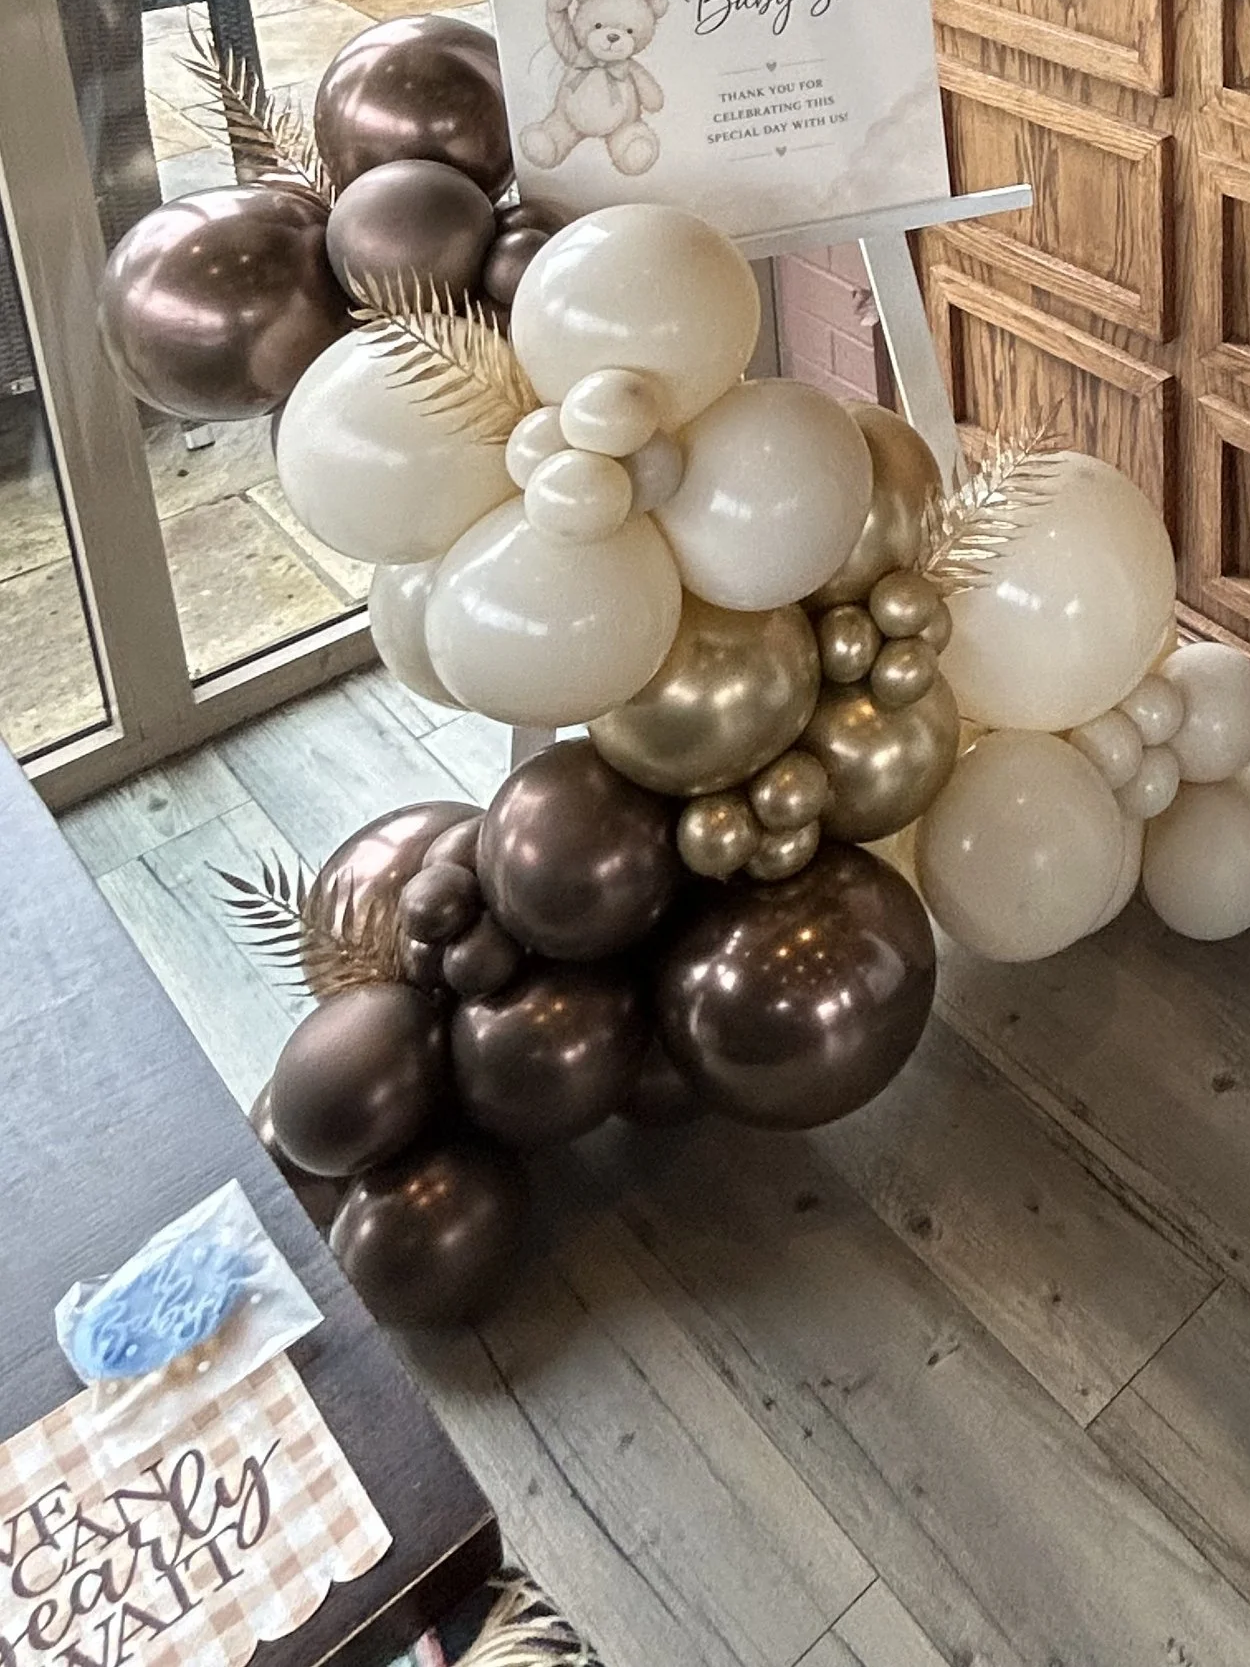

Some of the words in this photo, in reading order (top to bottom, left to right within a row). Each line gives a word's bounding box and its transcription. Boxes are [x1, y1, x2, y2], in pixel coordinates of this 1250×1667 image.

[718, 87, 765, 103] THANK
[768, 83, 796, 95] YOU
[798, 78, 823, 91] FOR
[713, 100, 802, 123] CELEBRATING
[805, 95, 836, 109] THIS
[707, 127, 760, 144] SPECIAL
[763, 122, 788, 136] DAY
[792, 117, 826, 131] WITH
[829, 111, 849, 125] US!
[12, 1458, 174, 1599] CAN
[0, 1438, 281, 1667] early
